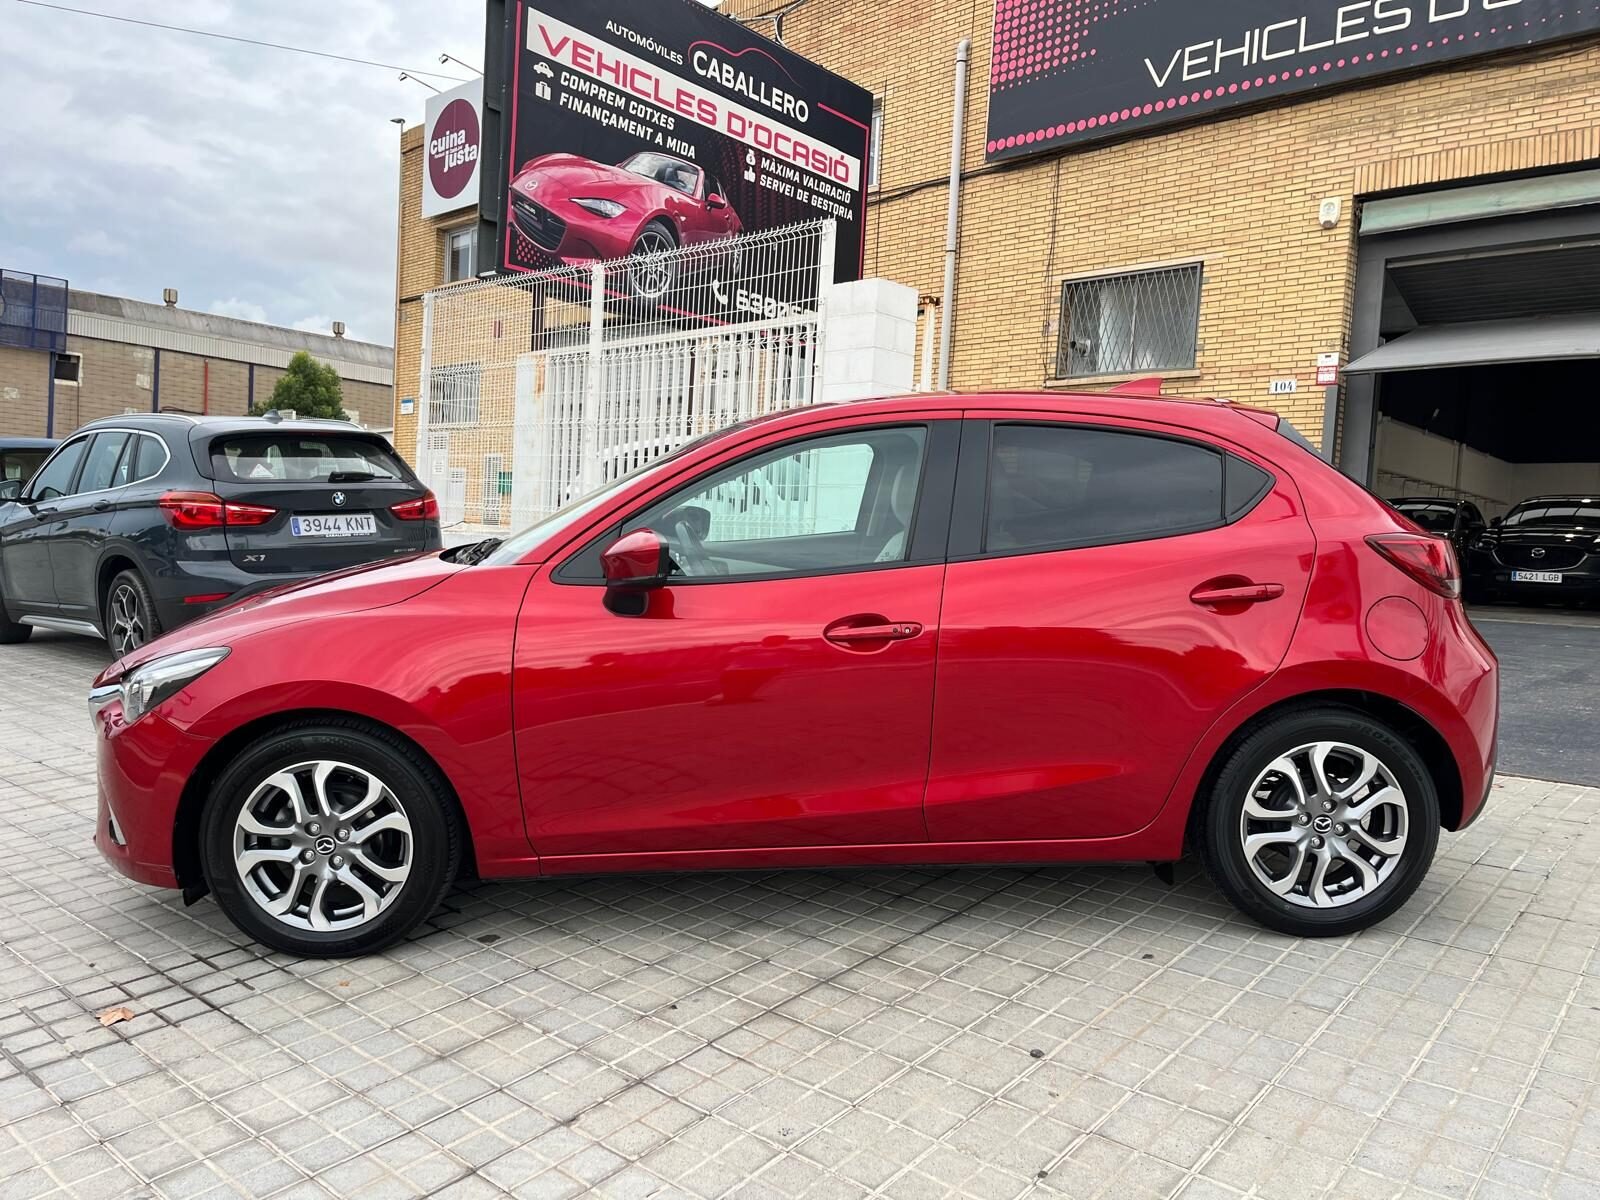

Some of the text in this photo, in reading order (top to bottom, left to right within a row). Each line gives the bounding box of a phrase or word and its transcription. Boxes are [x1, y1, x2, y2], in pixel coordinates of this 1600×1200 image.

[1144, 0, 1411, 87] VEHICLES
[605, 20, 809, 123] AUTOMÓVILES CABALLERO
[538, 24, 850, 184] VEHICLES D'OCASIÓ
[560, 71, 675, 131] COMPREM COTXES
[430, 129, 466, 155] cuina
[559, 92, 696, 159] FINANÇAMENT A MIDA
[444, 143, 478, 173] justa
[761, 157, 852, 204] MÀXIMA VALORACIÓ
[760, 174, 853, 221] SERVEI DE GESTORIA
[1274, 381, 1293, 392] 104
[302, 516, 371, 533] 3944 KNT
[243, 554, 266, 562] X1
[1517, 572, 1539, 581] 5421
